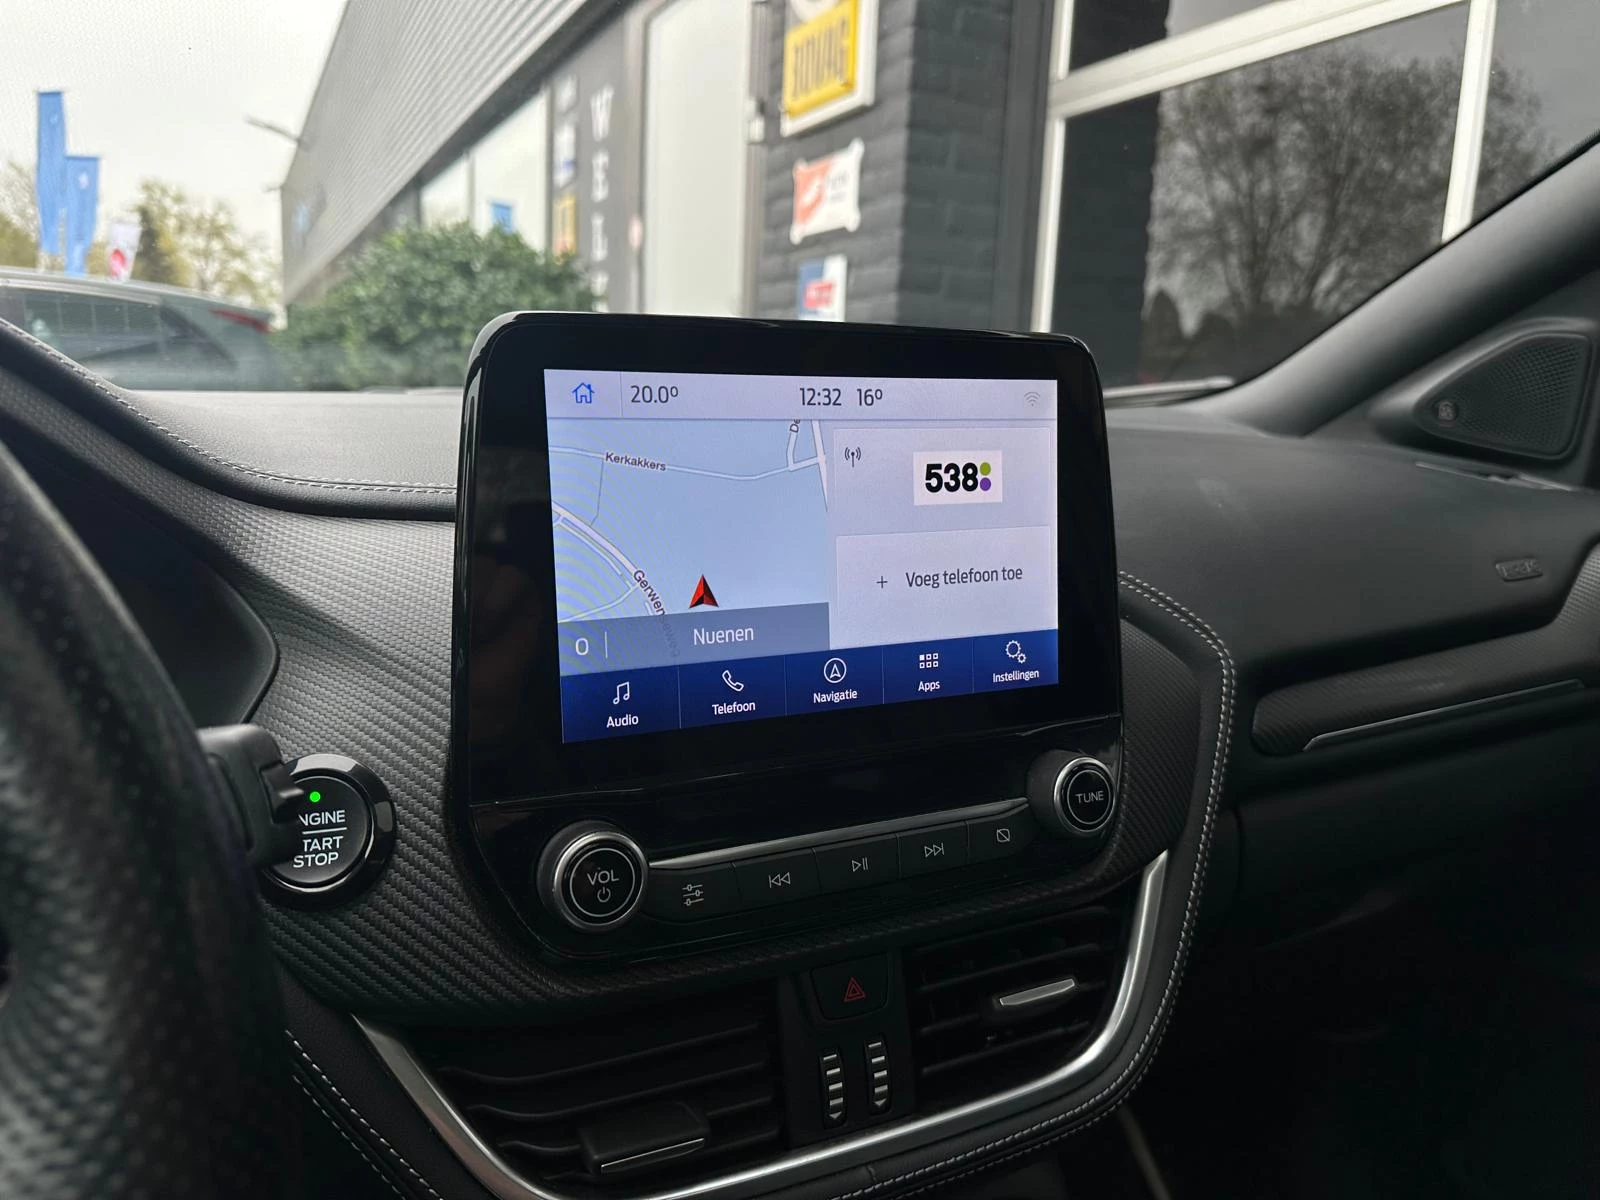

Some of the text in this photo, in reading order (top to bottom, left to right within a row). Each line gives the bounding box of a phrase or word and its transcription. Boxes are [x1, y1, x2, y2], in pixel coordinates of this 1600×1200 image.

[630, 385, 679, 403] 20.0°
[800, 388, 842, 406] 12:32
[605, 452, 666, 471] Kerkakkers
[925, 462, 979, 493] 538
[905, 566, 1023, 588] Voeg telefoon toe
[693, 627, 754, 645] Nuenen
[992, 669, 1040, 683] Instellingen
[918, 680, 940, 692] Apps
[813, 688, 858, 704] Navigatie
[712, 701, 756, 715] Telefoon
[606, 713, 639, 728] Audio
[1075, 790, 1104, 804] TUNE
[298, 809, 346, 826] NGINE
[302, 835, 344, 852] TART
[292, 851, 339, 868] STOP
[586, 869, 620, 886] VOL
